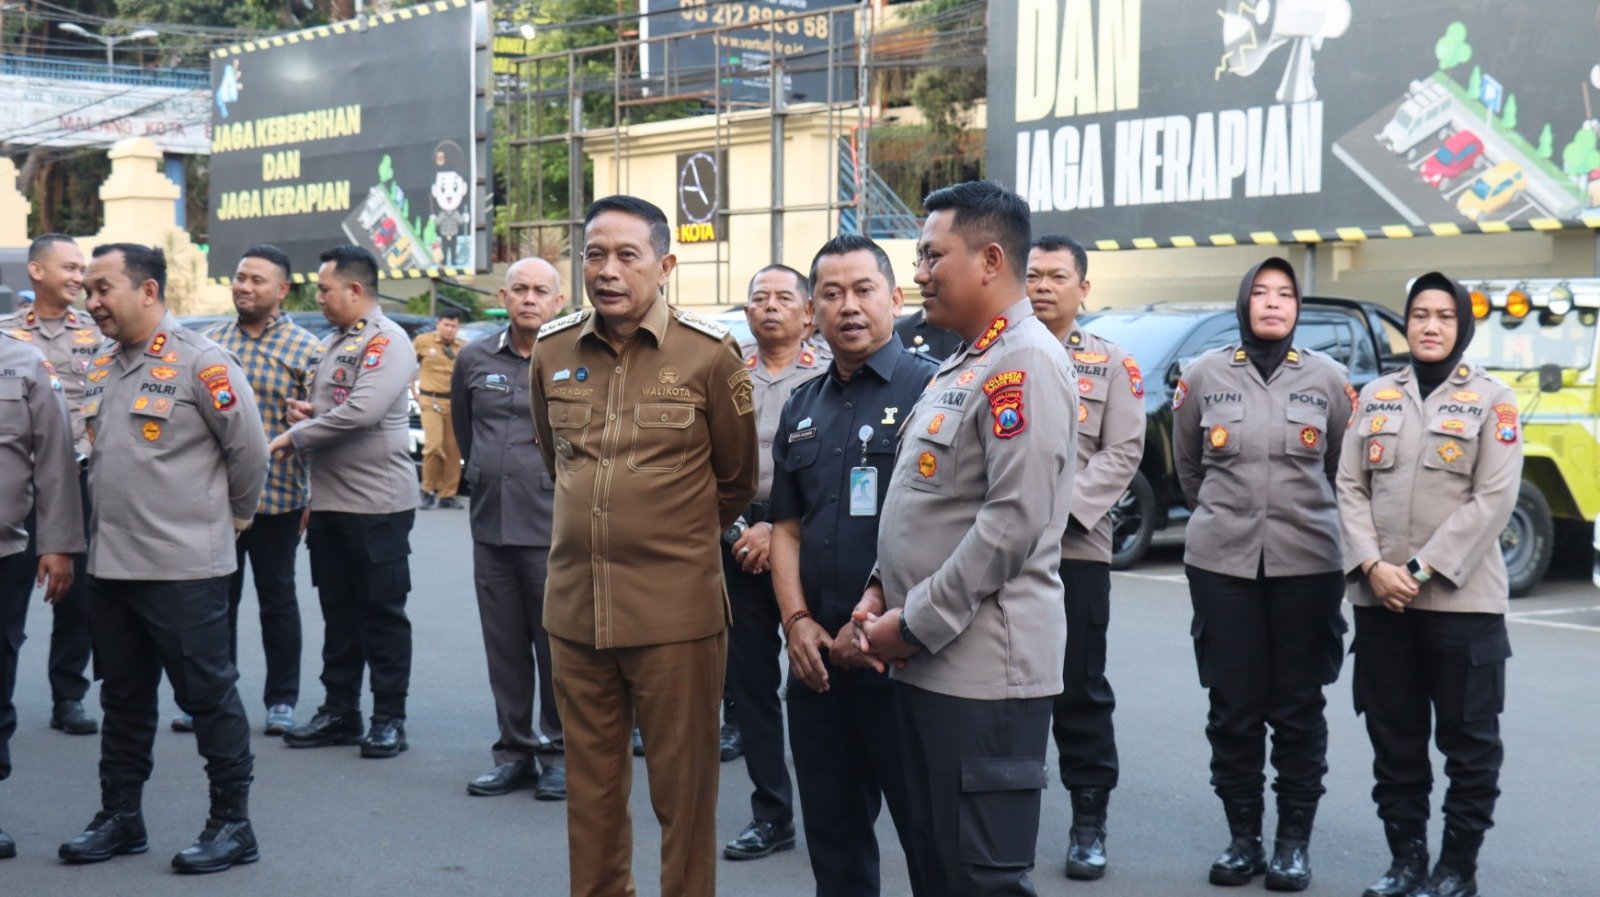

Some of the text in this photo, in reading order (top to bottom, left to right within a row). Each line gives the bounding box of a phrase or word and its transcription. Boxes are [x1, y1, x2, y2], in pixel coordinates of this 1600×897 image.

[1015, 0, 1140, 123] DAN
[212, 121, 255, 153] JAGA
[256, 104, 361, 147] KEBERSIHAN
[1114, 101, 1323, 207] KERAPIAN
[262, 150, 300, 182] DAN
[217, 180, 350, 221] JAGA KERAPIAN
[681, 222, 715, 242] KOTA
[140, 383, 177, 395] POLRI
[642, 387, 691, 398] WALIKOTA
[1203, 393, 1242, 404] YUNI
[1289, 393, 1328, 410] POLRI
[1365, 403, 1403, 413] DIANA
[1438, 404, 1483, 417] POLRI
